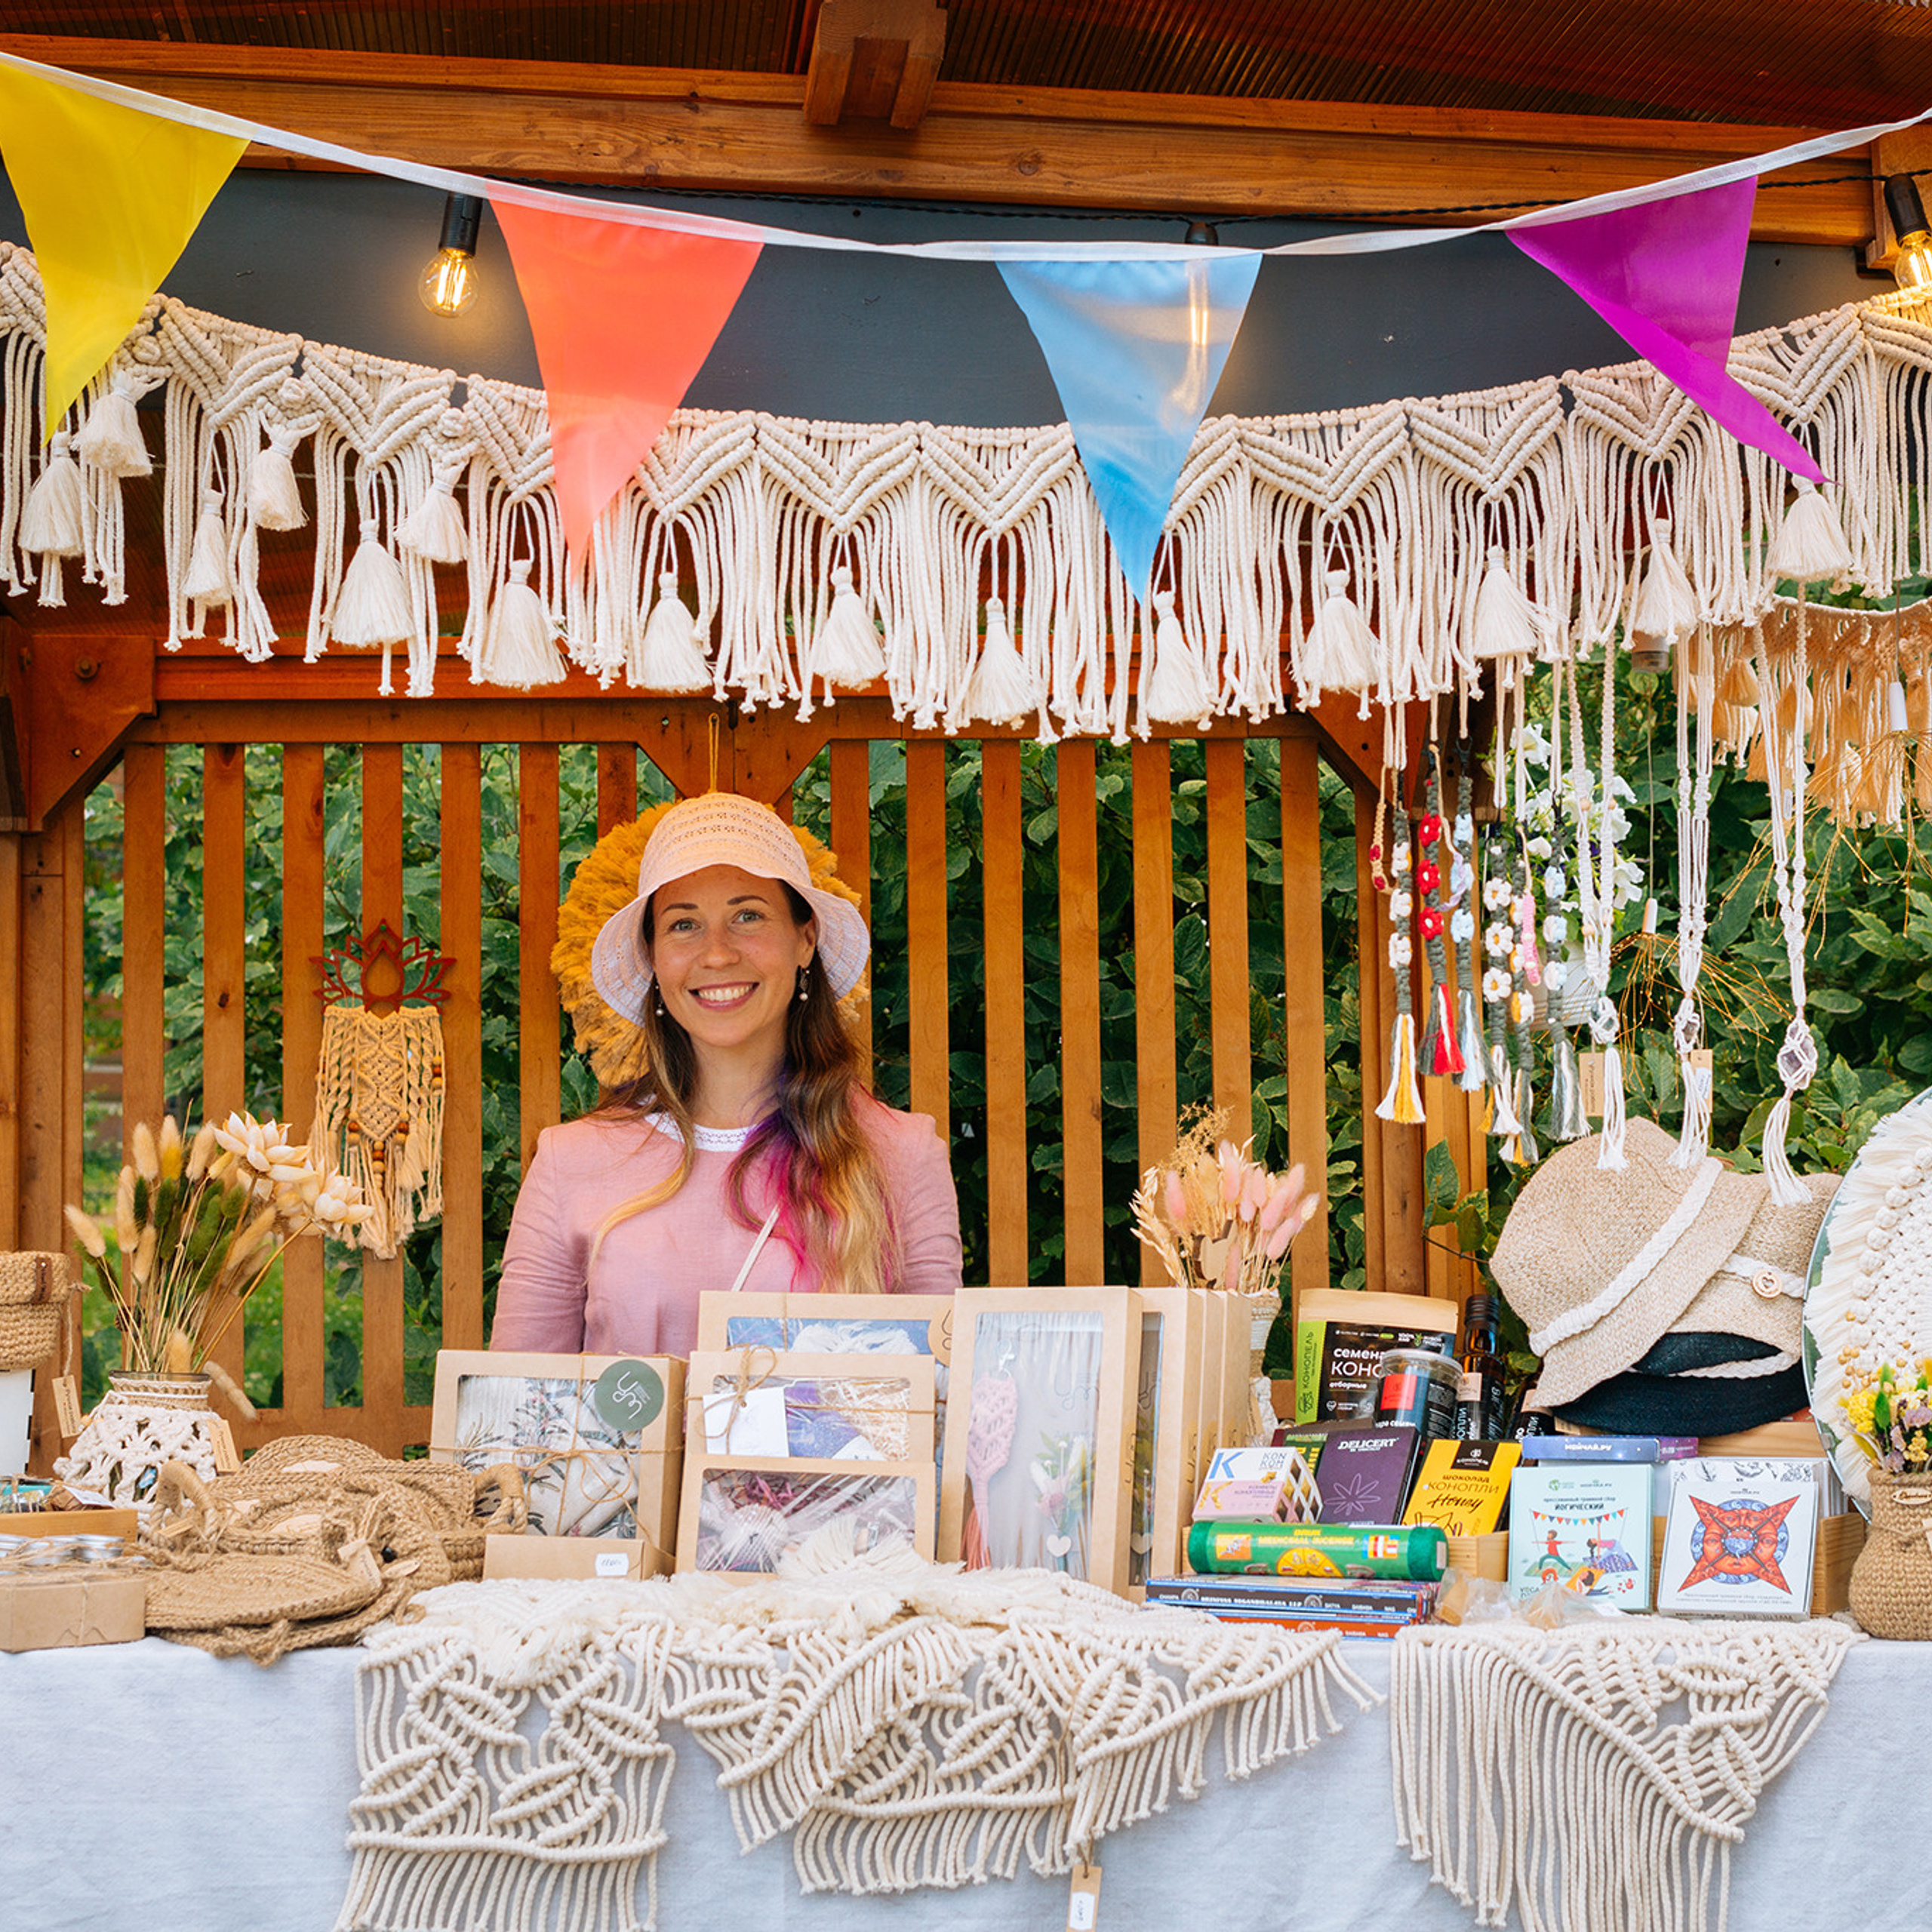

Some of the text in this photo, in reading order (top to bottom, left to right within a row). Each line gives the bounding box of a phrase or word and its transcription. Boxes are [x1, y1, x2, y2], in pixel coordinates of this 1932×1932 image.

[1302, 1331, 1314, 1388] КОНОПЕЛЬ
[1331, 1361, 1382, 1377] КОНО
[1329, 1381, 1367, 1389] отборные
[1337, 1438, 1397, 1450] DELICERT
[1442, 1475, 1490, 1483] шоколад
[1426, 1481, 1500, 1494] КОНОПЛИ
[1426, 1494, 1484, 1514] Honey
